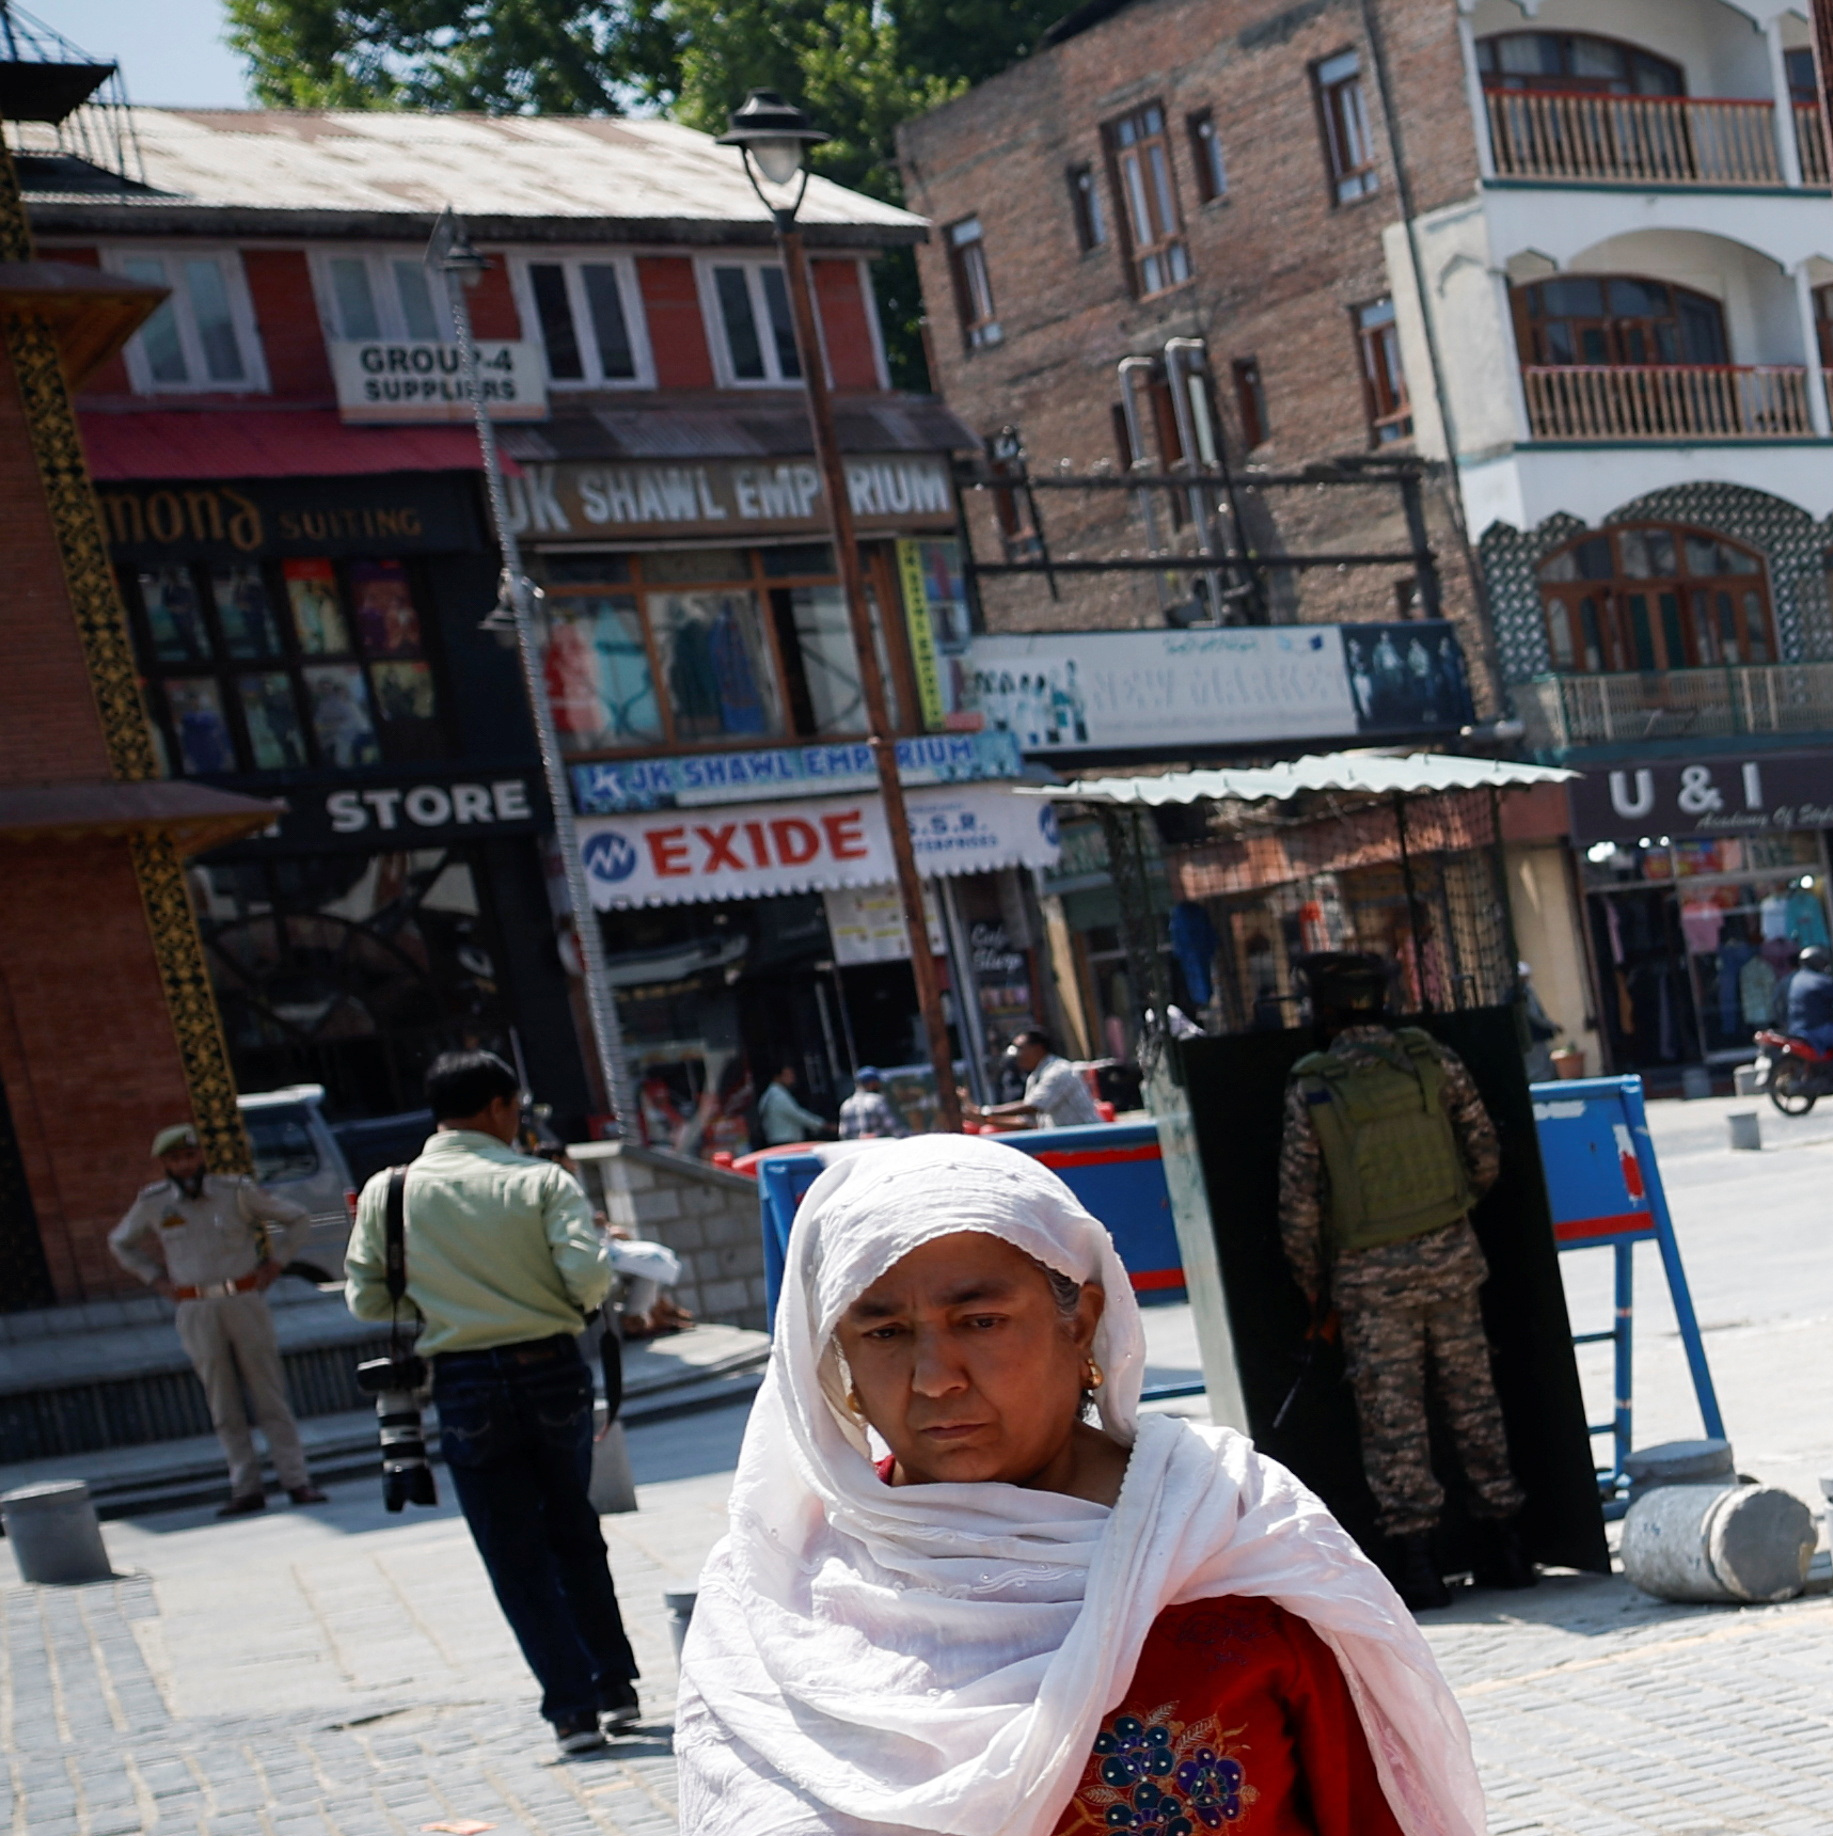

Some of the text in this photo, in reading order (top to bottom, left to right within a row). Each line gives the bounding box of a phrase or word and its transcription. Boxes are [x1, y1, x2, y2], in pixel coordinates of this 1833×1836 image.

[578, 464, 728, 524] SHAWL
[733, 464, 951, 521] EMPRIUM
[630, 736, 976, 791] JK SHAWL EMPRIUM
[1609, 761, 1765, 820] U & I
[326, 780, 532, 833] STORE
[643, 810, 869, 878] EXIDE
